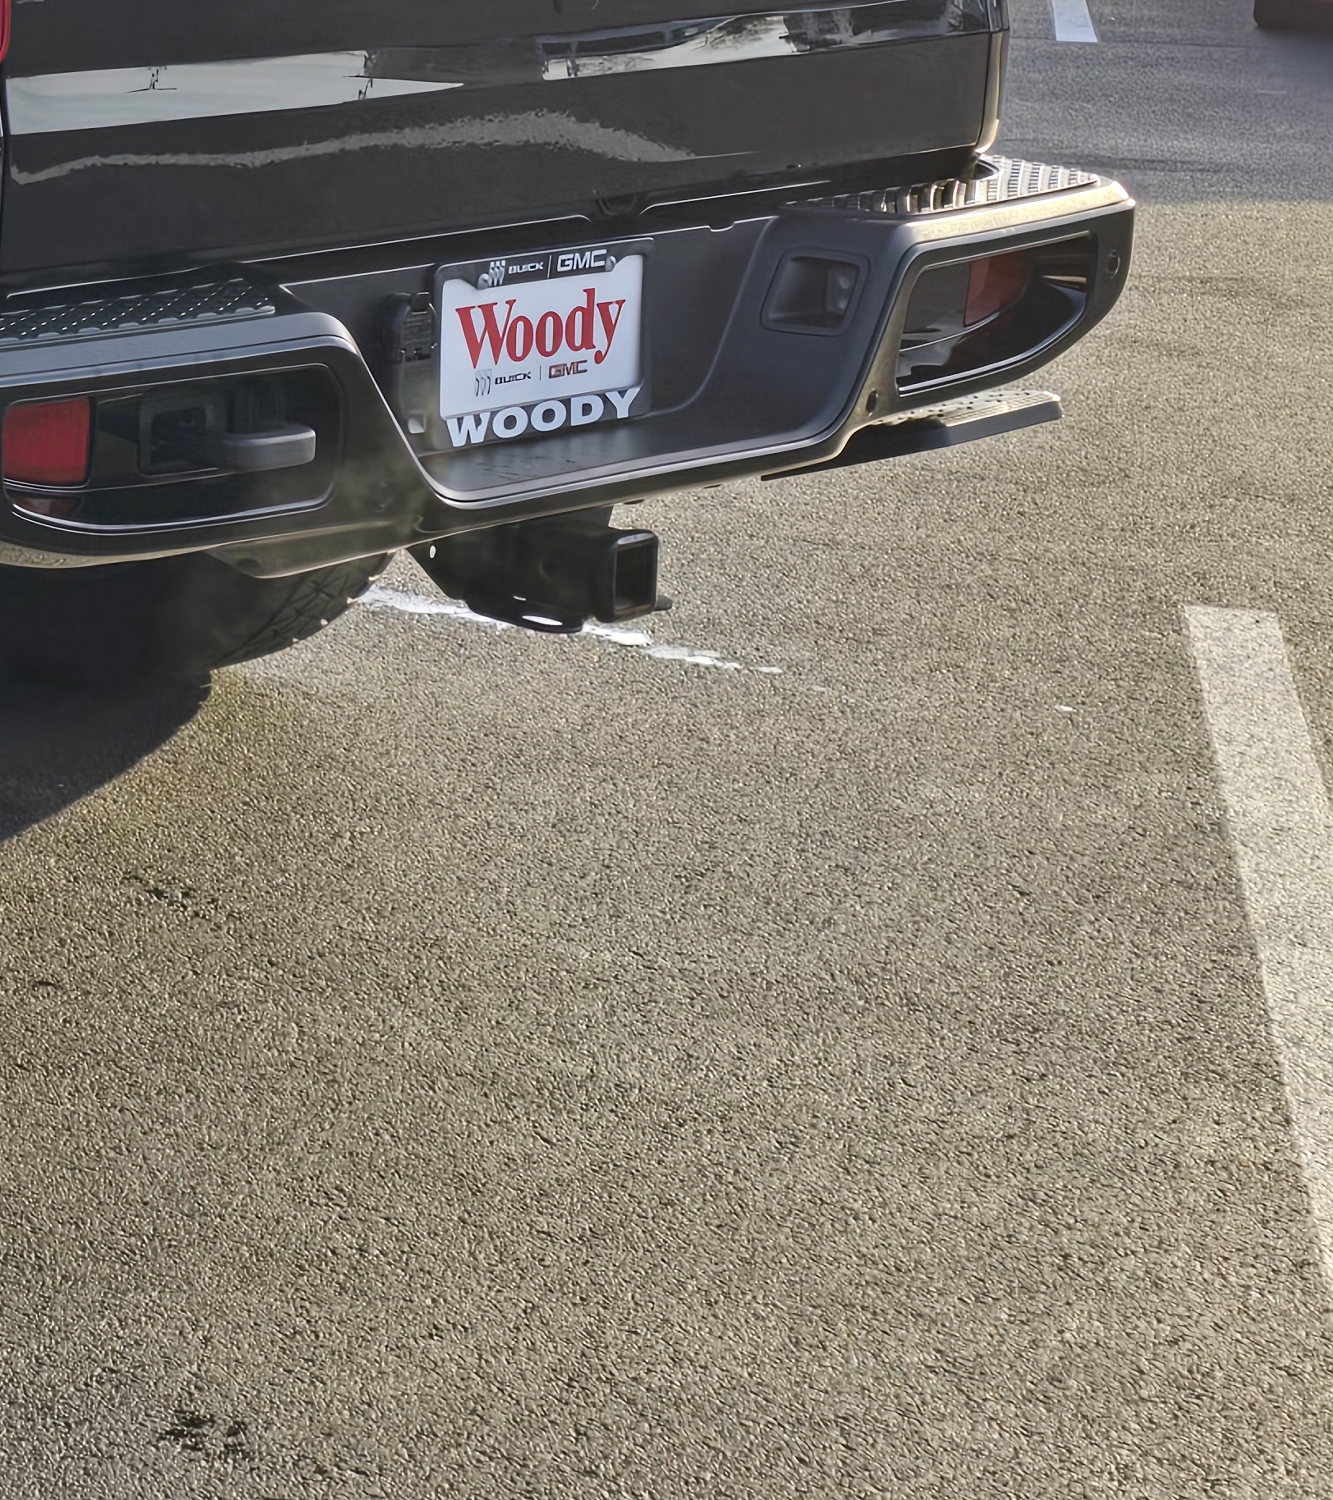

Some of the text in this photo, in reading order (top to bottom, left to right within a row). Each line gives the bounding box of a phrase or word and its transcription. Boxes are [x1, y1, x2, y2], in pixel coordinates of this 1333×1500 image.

[508, 249, 607, 275] BUICK GMC
[455, 288, 626, 369] Woody
[494, 360, 588, 385] BUICK GMC
[446, 385, 642, 448] WOODY
